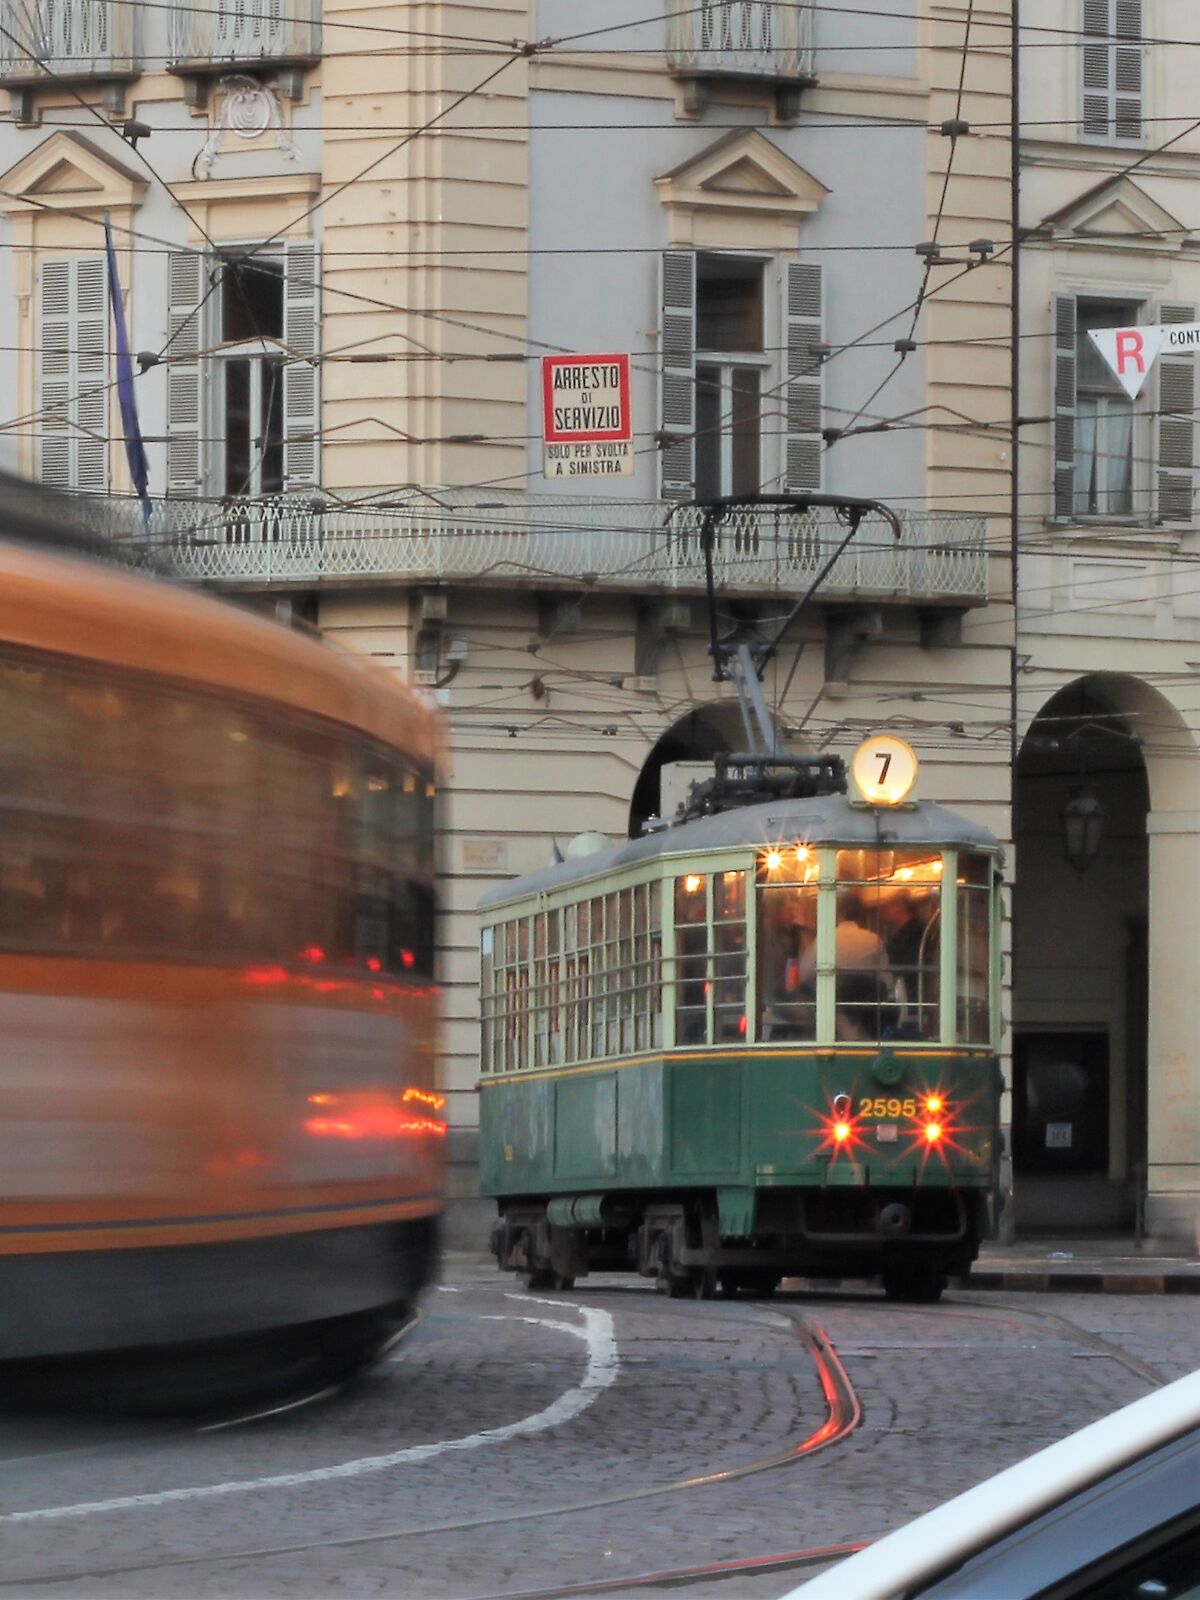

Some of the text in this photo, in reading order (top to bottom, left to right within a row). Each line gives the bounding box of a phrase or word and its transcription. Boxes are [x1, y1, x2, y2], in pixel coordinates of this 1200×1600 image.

[1169, 330, 1200, 345] CONT
[1115, 331, 1145, 374] R
[554, 366, 618, 389] ARRESTO
[581, 392, 592, 404] DI
[555, 406, 619, 430] SERVIZIO
[548, 443, 628, 459] SOLO PER SVOLTA
[556, 460, 622, 475] A SINISTRA
[875, 753, 892, 784] 7
[859, 1098, 916, 1118] 2595
